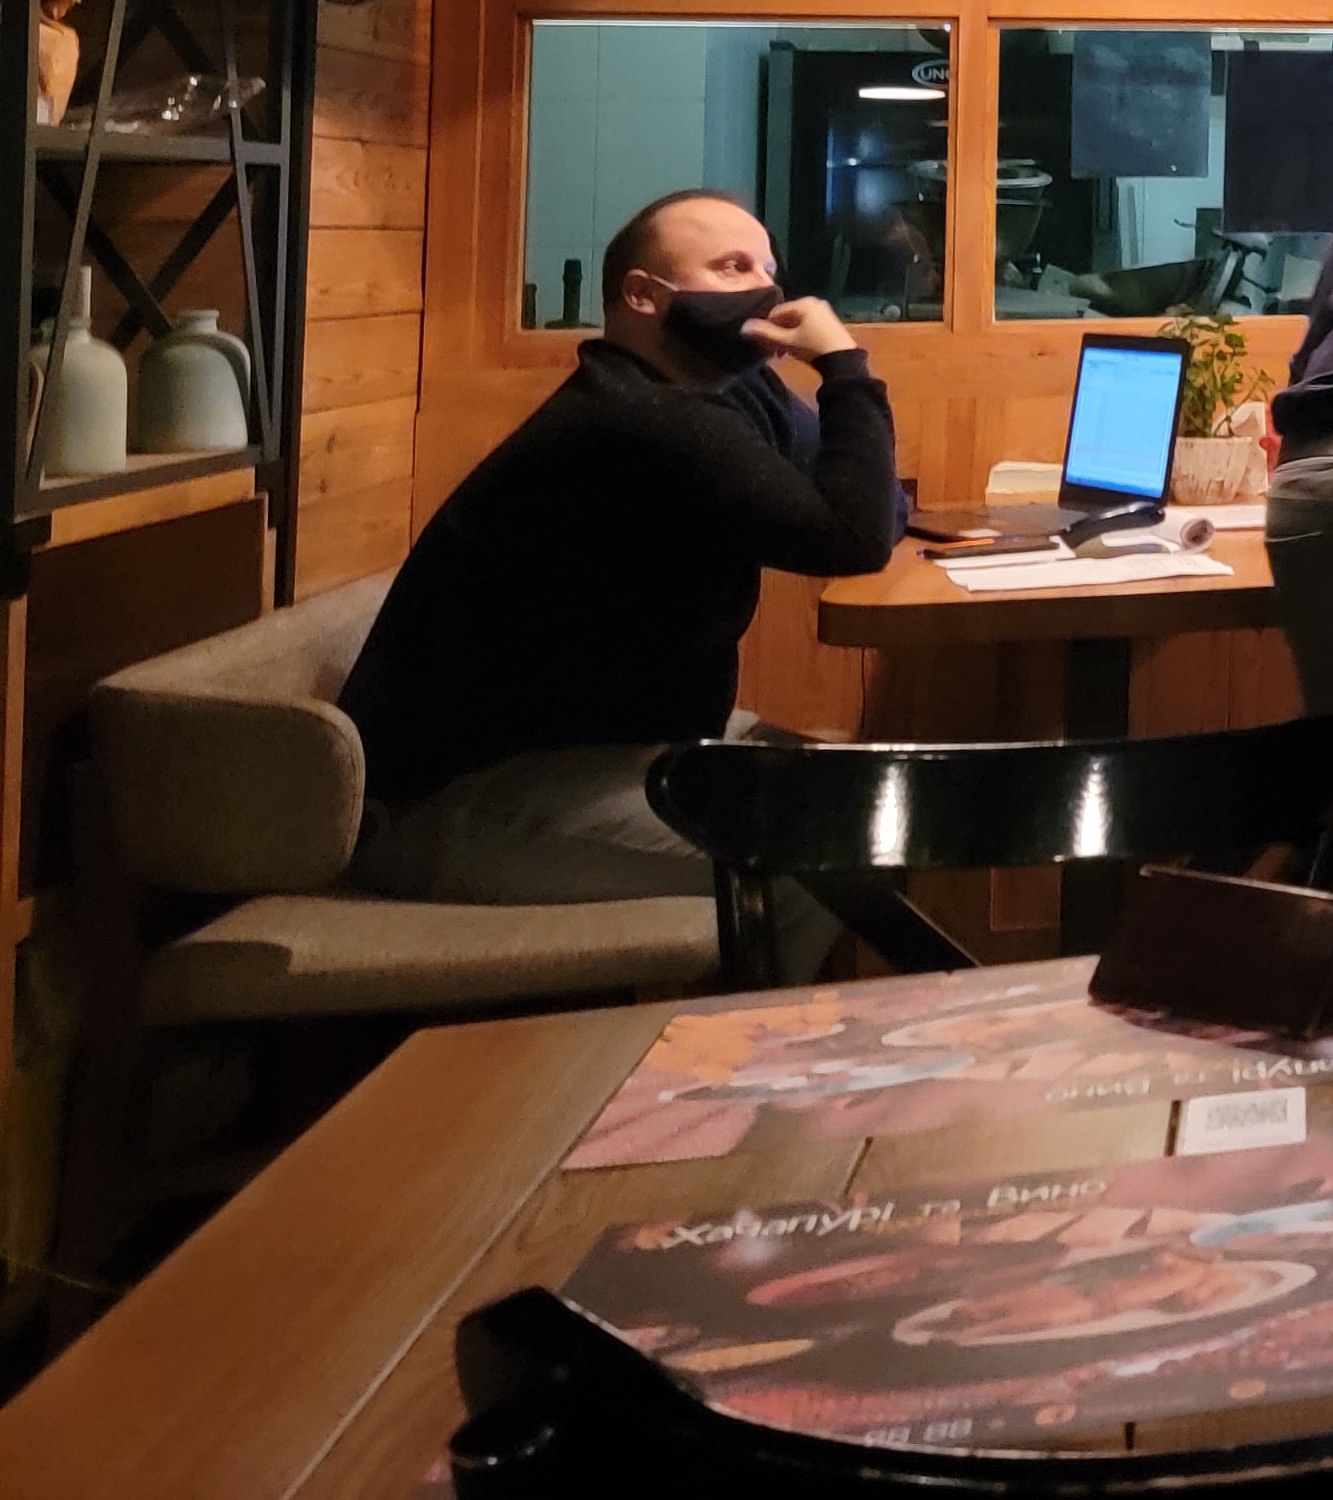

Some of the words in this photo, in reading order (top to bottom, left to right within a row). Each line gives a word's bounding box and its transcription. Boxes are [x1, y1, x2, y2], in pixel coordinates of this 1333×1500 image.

[661, 1201, 896, 1250] Хачапурі
[918, 1198, 962, 1217] та
[986, 1178, 1108, 1208] Вино
